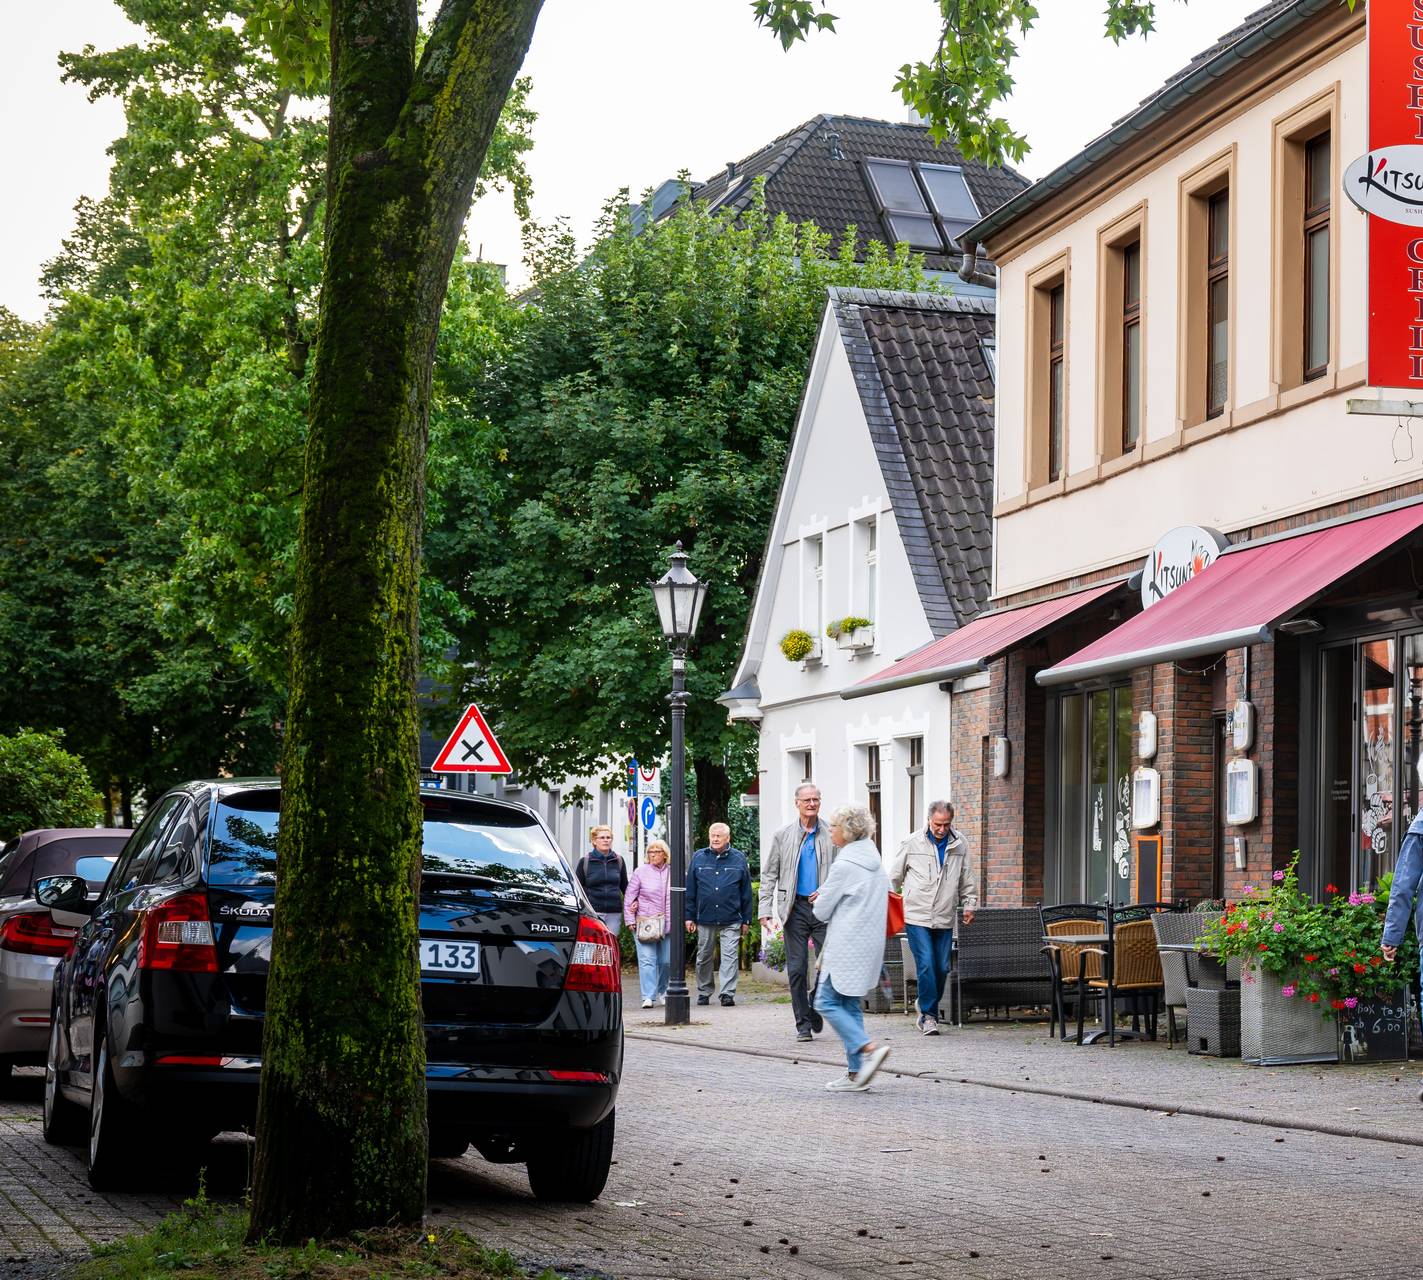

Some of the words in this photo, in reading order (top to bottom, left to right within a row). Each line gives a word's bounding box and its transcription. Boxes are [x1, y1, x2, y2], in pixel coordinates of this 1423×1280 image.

[220, 905, 271, 916] ŠKODA
[531, 923, 570, 934] RAPID
[428, 943, 476, 969] 133
